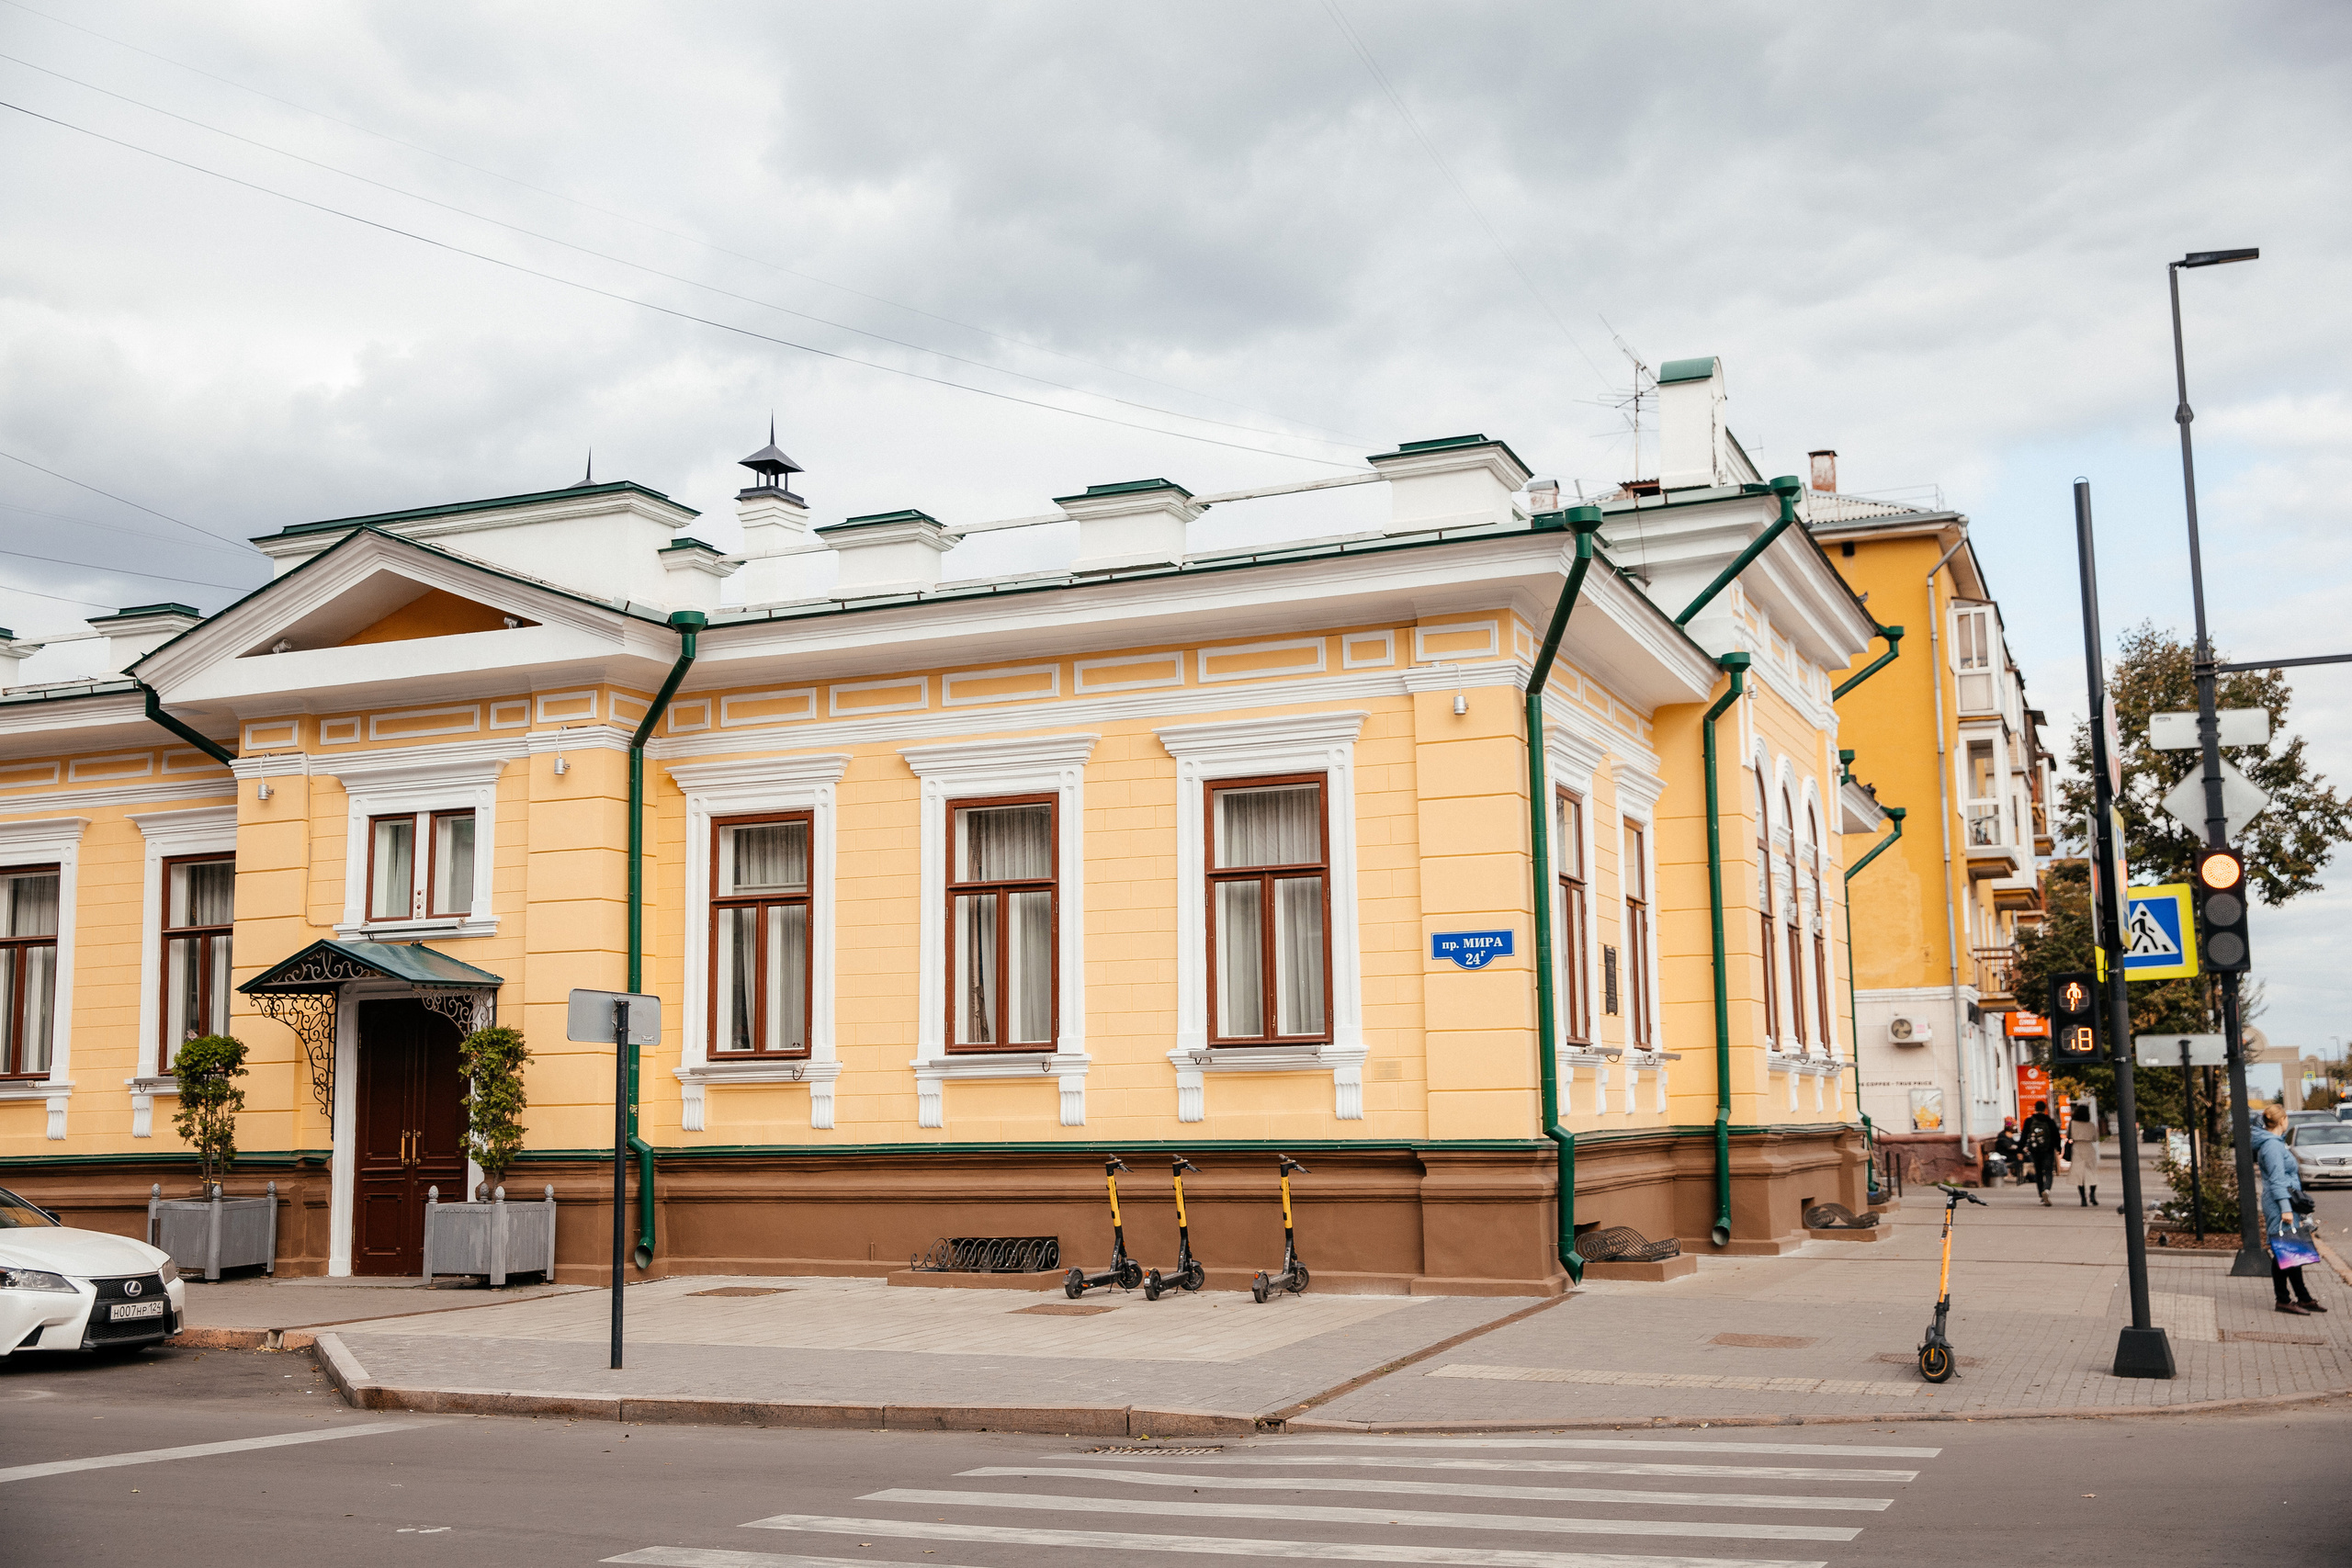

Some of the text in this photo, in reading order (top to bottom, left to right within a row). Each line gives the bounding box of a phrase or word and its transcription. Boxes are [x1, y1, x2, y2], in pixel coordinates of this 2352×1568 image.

[1442, 937, 1503, 951] пр. МИРА
[149, 1303, 161, 1312] 124
